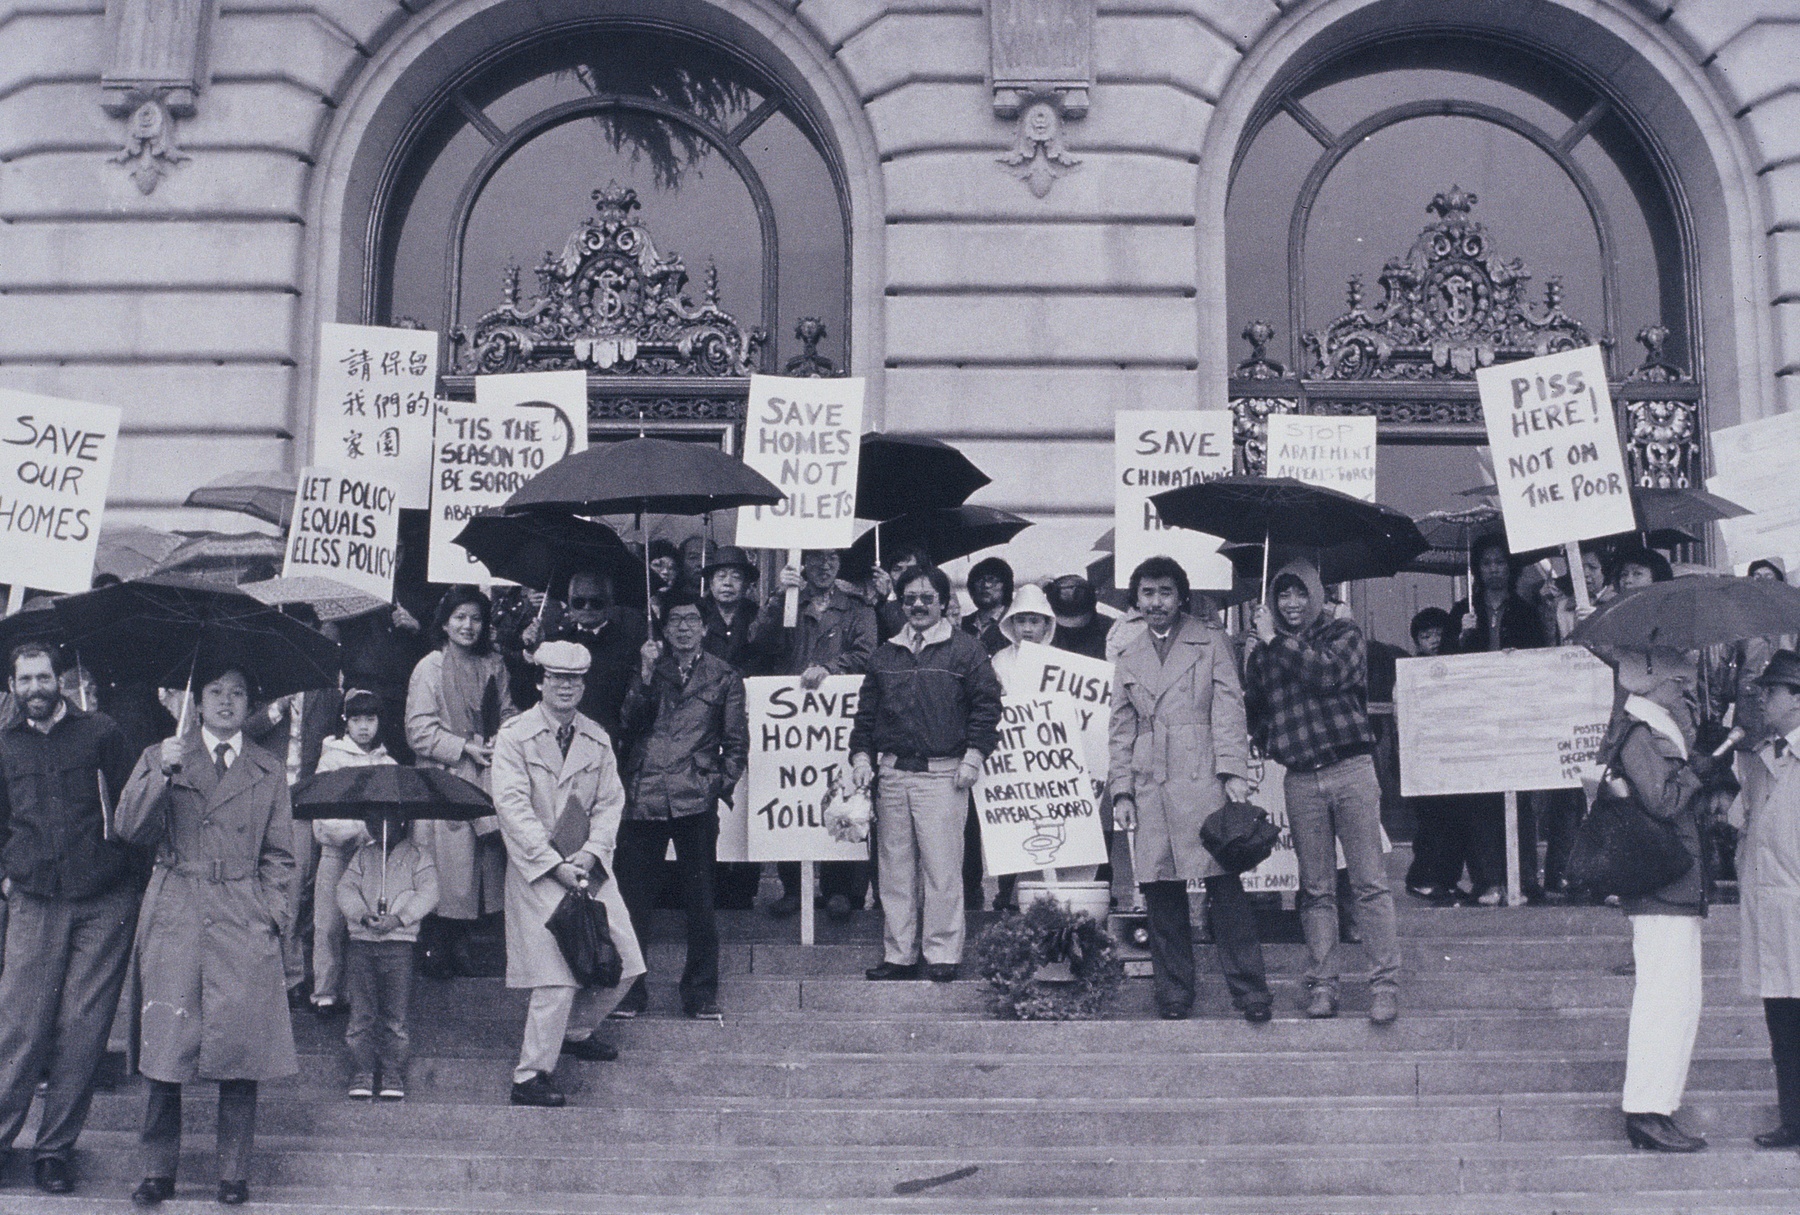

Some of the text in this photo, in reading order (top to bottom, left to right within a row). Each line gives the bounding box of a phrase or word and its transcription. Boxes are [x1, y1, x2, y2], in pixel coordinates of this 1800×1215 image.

[339, 348, 428, 382] 請保留
[342, 389, 430, 419] 我們的
[760, 396, 844, 427] SAVE
[1512, 386, 1599, 438] HERE!
[2, 415, 106, 461] SAVE
[342, 427, 400, 459] 家園
[502, 417, 543, 442] THE
[759, 427, 852, 456] HOMES
[1135, 429, 1221, 457] SAVE
[1286, 423, 1353, 442] STOP
[440, 442, 545, 470] SEASON TO
[1508, 441, 1599, 479] NOT ON
[17, 461, 84, 495] OUR
[441, 468, 464, 492] BE
[780, 458, 848, 486] NOT
[338, 478, 396, 515] POLICY
[1521, 472, 1623, 508] THE POOR
[0, 496, 91, 541] HOMES
[300, 506, 376, 539] EQUALS
[346, 541, 395, 580] POLICY
[766, 686, 858, 719] SAVE
[1036, 721, 1068, 747] ON
[779, 763, 839, 789] NOT
[1023, 748, 1084, 774] POOR,
[984, 777, 1080, 803] ABATEMENT
[985, 800, 1093, 824] APPEALS BOARD
